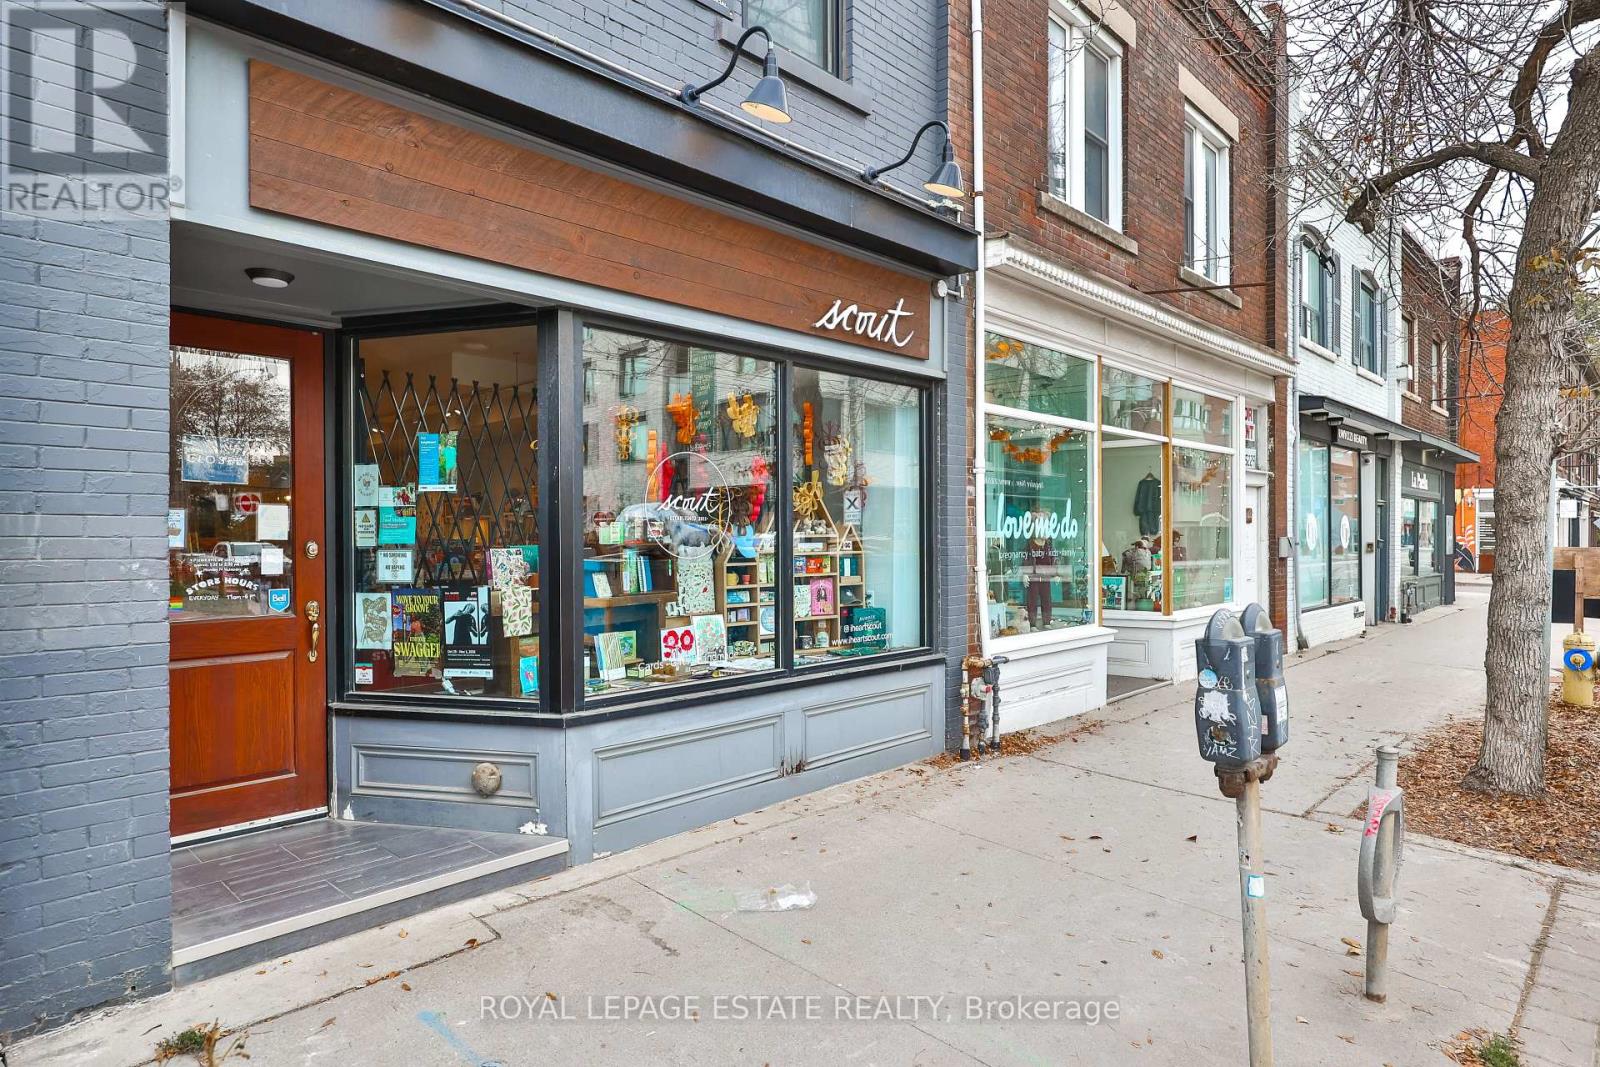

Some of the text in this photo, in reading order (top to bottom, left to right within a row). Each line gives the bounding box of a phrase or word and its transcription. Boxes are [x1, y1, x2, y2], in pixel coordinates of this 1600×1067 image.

[812, 298, 915, 347] scout
[657, 486, 721, 513] scout
[999, 550, 1029, 561] pregnancy
[186, 577, 259, 596] STORE HOURS
[272, 594, 287, 602] Bell
